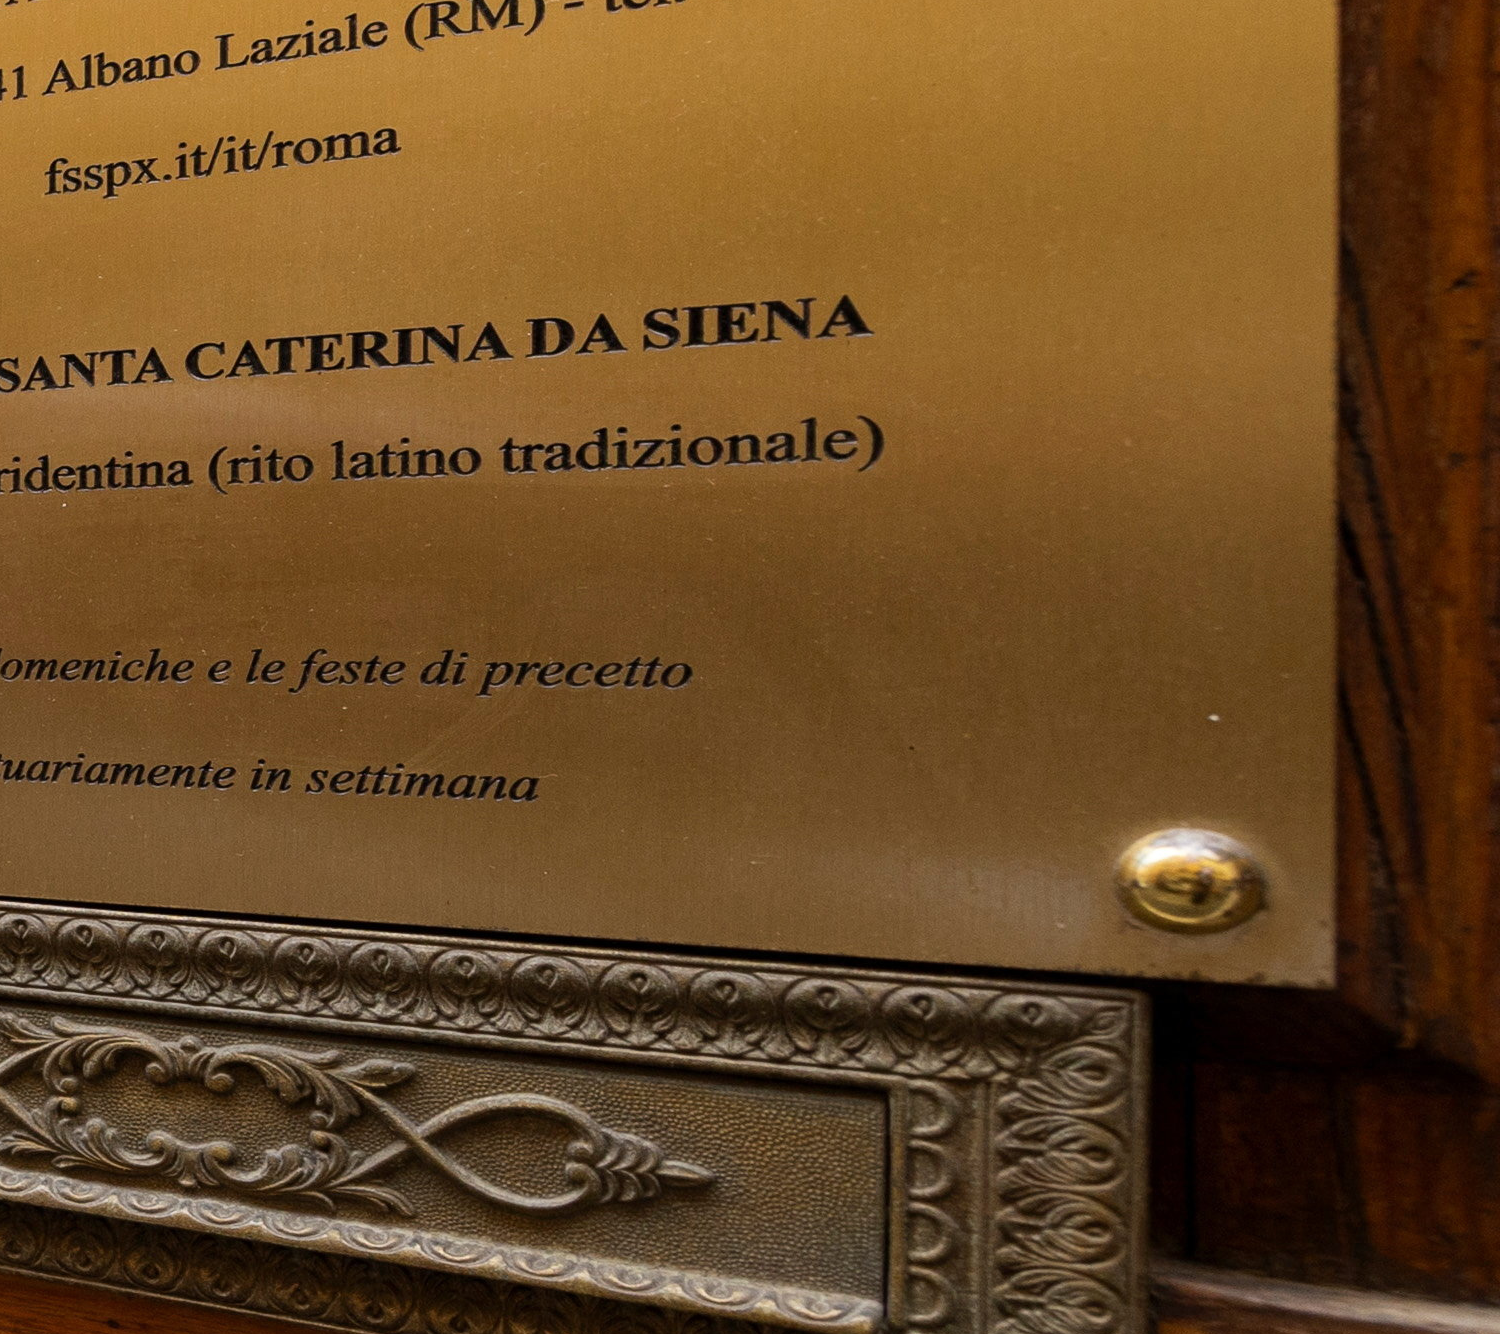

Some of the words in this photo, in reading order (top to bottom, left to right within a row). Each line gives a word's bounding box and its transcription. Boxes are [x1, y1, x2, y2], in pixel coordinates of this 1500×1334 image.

[41, 49, 201, 97] Albano
[214, 12, 389, 71] Laziale
[563, 0, 585, 10] -
[44, 127, 402, 200] fsspx.it/it/roma
[184, 321, 515, 380] CATERINA
[524, 313, 629, 358] DA
[642, 294, 875, 352] SIENA
[208, 443, 315, 495] (rito
[330, 437, 482, 481] latino
[498, 414, 885, 474] tradizionale)
[207, 659, 232, 683] e
[245, 648, 287, 683] le
[287, 648, 407, 694] feste
[419, 648, 469, 686] di
[475, 656, 694, 697] precetto
[249, 758, 292, 792] in
[304, 762, 540, 802] settimana
